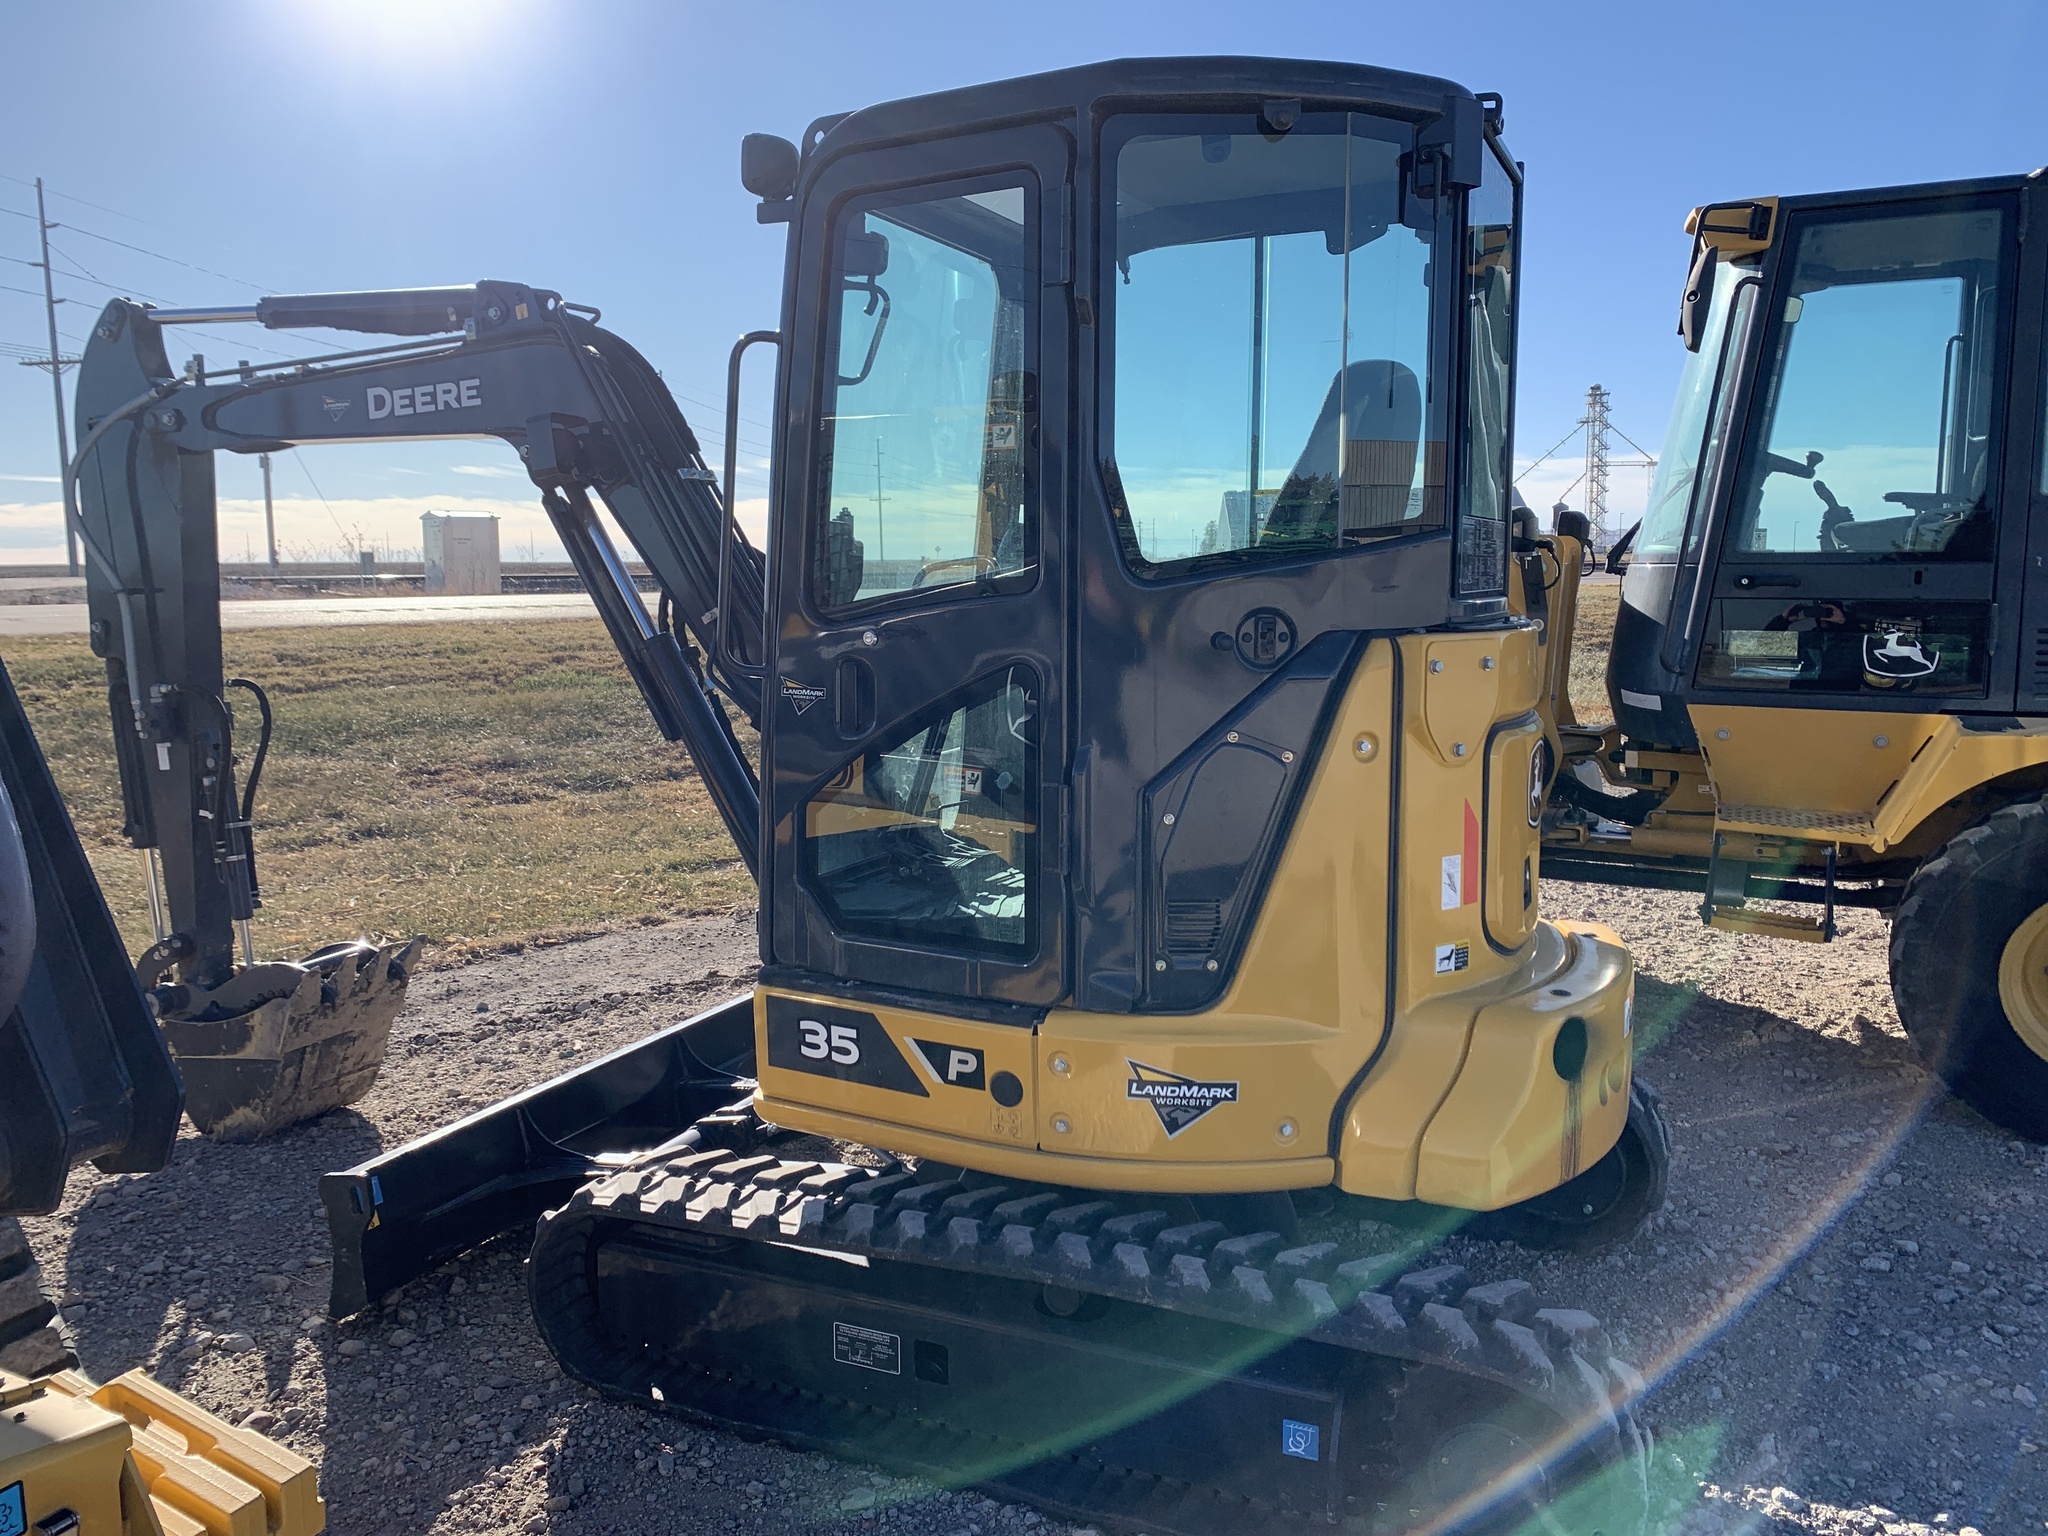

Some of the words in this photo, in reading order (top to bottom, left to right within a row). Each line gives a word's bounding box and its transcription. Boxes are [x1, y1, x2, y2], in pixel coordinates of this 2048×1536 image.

[366, 378, 482, 420] DEERE
[783, 687, 824, 697] LANDMARK
[799, 1020, 860, 1065] 35
[947, 1049, 978, 1081] P
[1131, 1082, 1235, 1099] LANDMARK
[1156, 1097, 1213, 1107] WORKSITE
